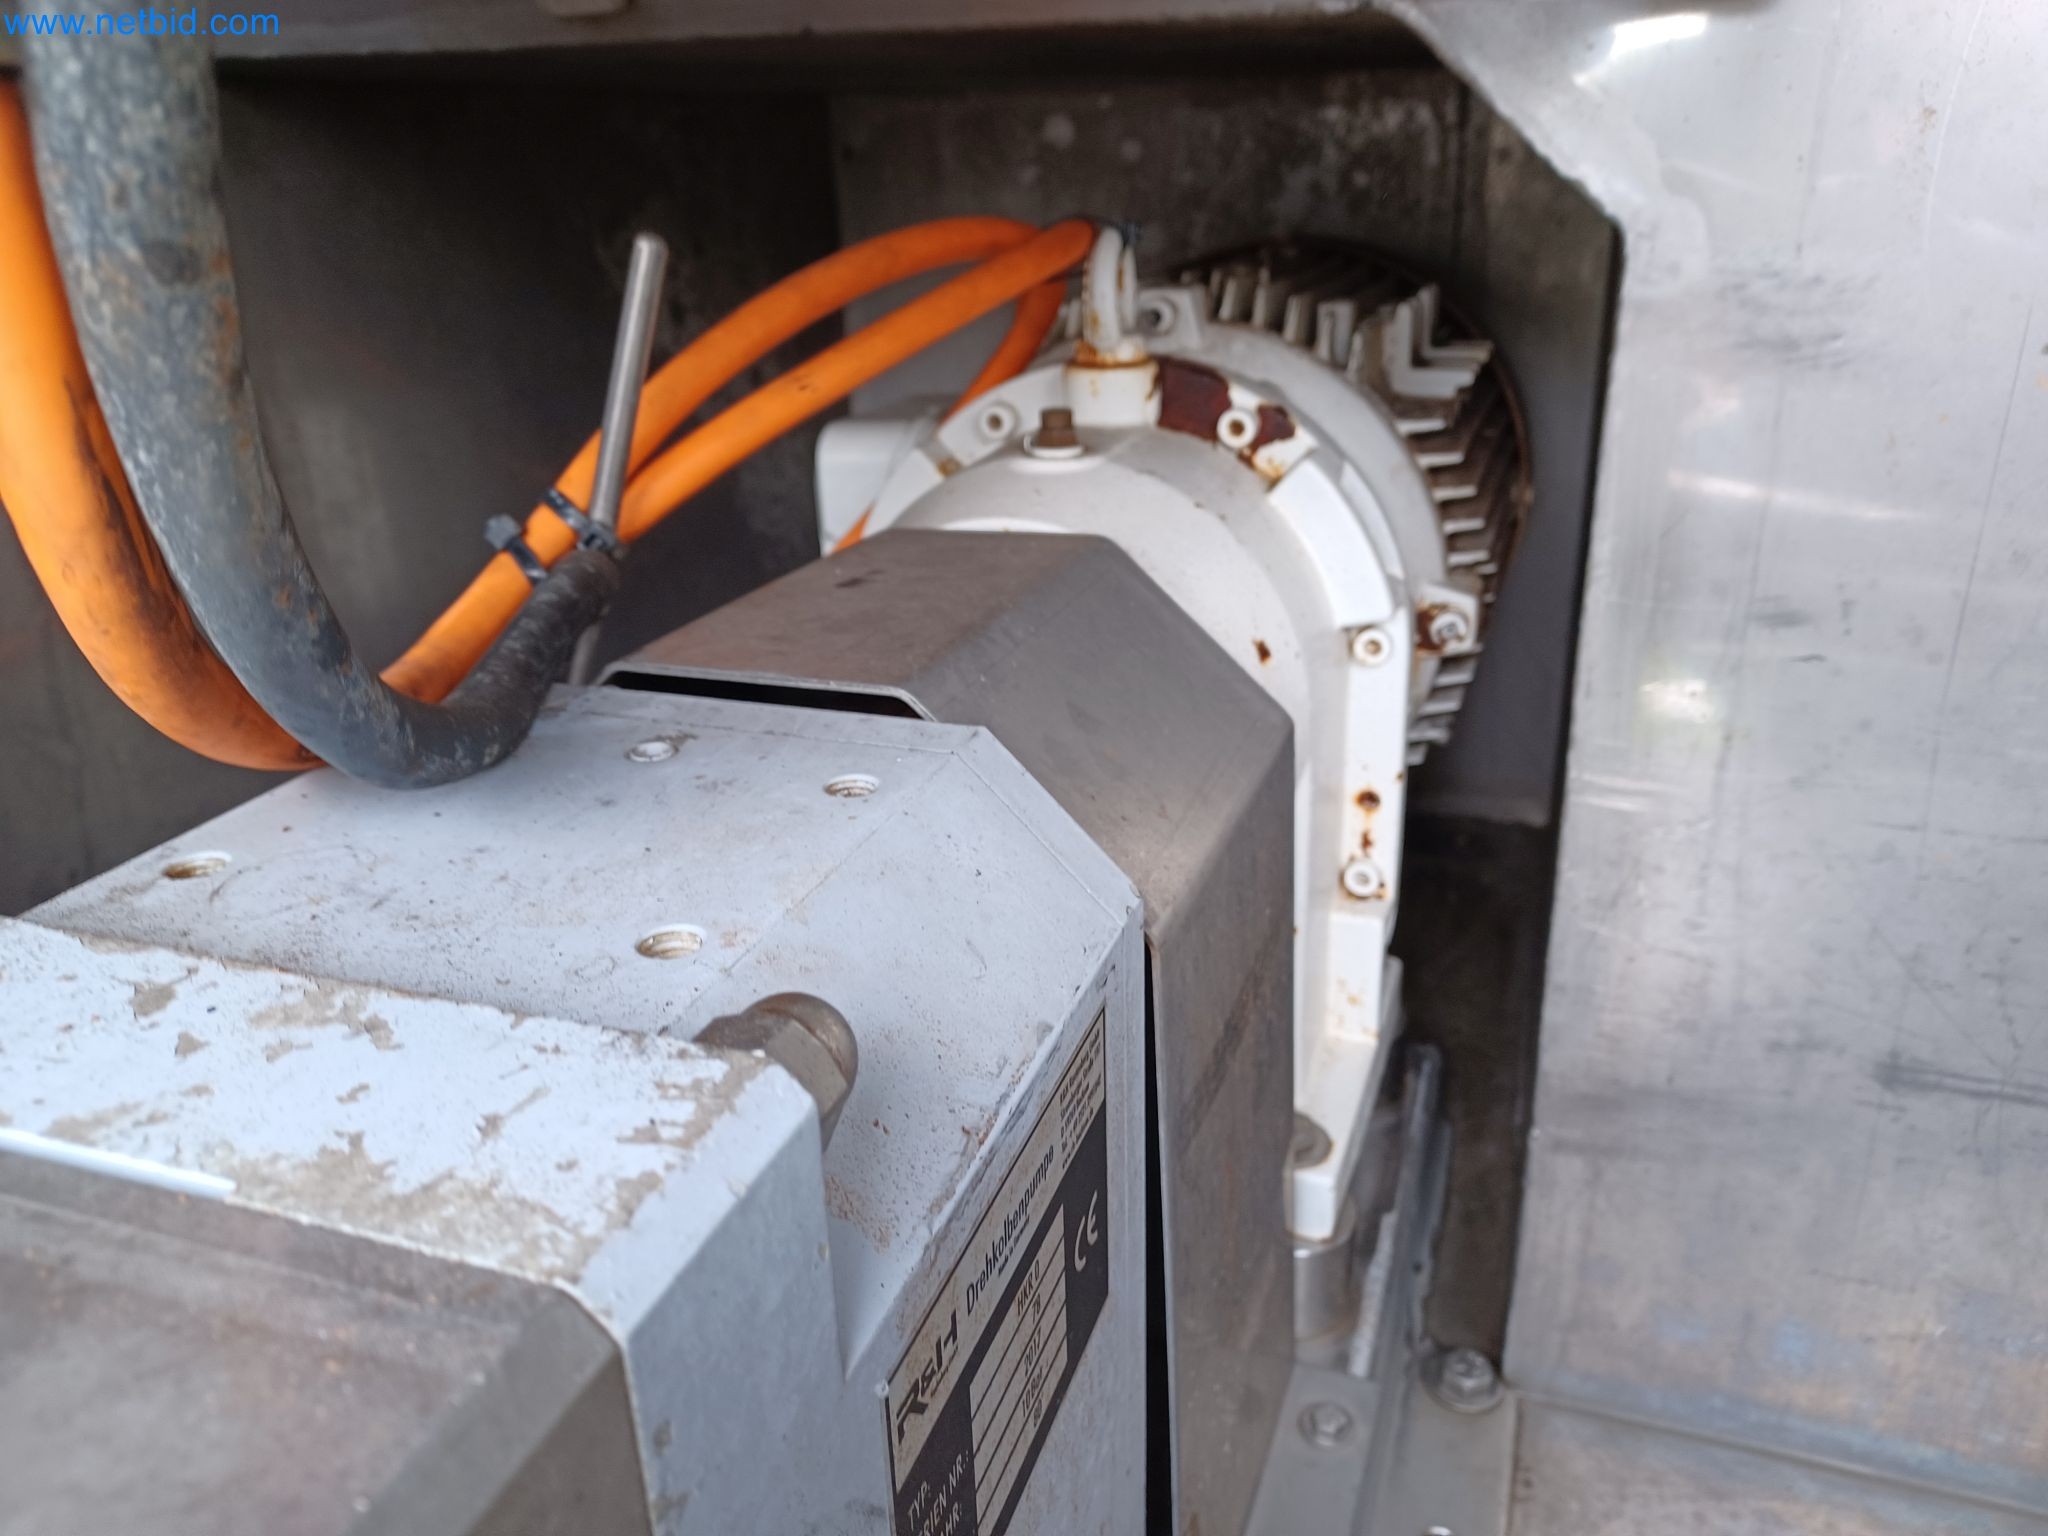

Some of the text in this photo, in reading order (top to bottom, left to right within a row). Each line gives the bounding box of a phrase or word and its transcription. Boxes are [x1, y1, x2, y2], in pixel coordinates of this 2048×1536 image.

[966, 1145, 1054, 1316] Drehkolbenpumpe
[1017, 1273, 1033, 1317] HKR
[896, 1307, 958, 1445] R&H
[1024, 1326, 1042, 1378] 2017
[949, 1450, 969, 1495] NR.:
[907, 1480, 931, 1531] TYP:
